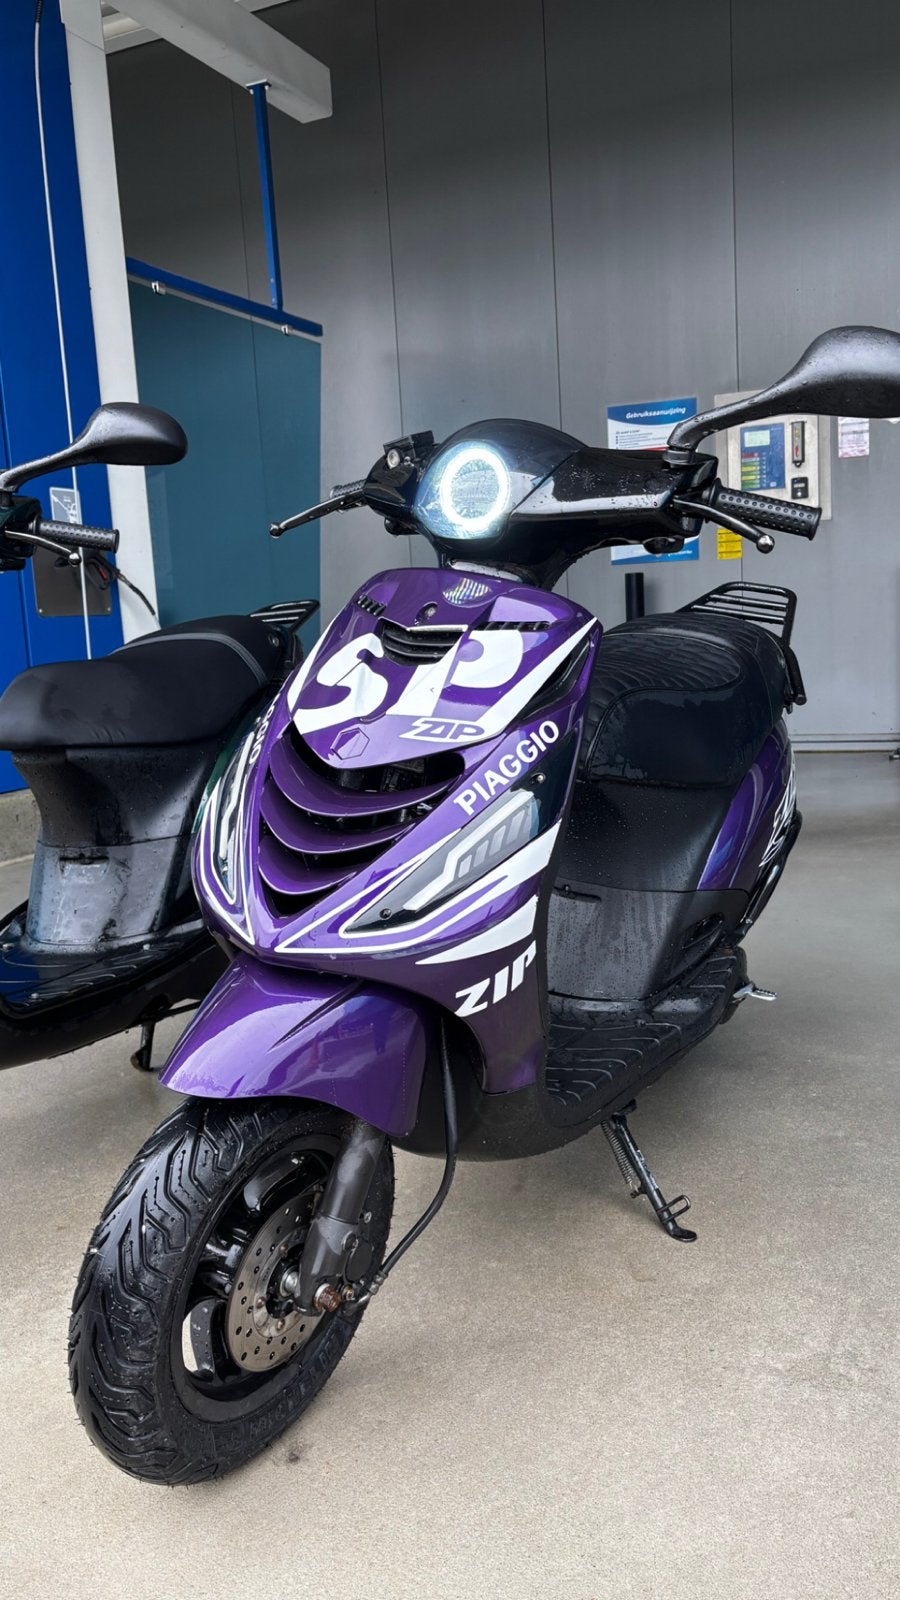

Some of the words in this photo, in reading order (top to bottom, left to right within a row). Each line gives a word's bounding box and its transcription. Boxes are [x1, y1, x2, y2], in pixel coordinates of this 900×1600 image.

[293, 628, 524, 736] SP
[453, 719, 561, 817] PIAGGIO
[454, 939, 538, 1018] ZIP
